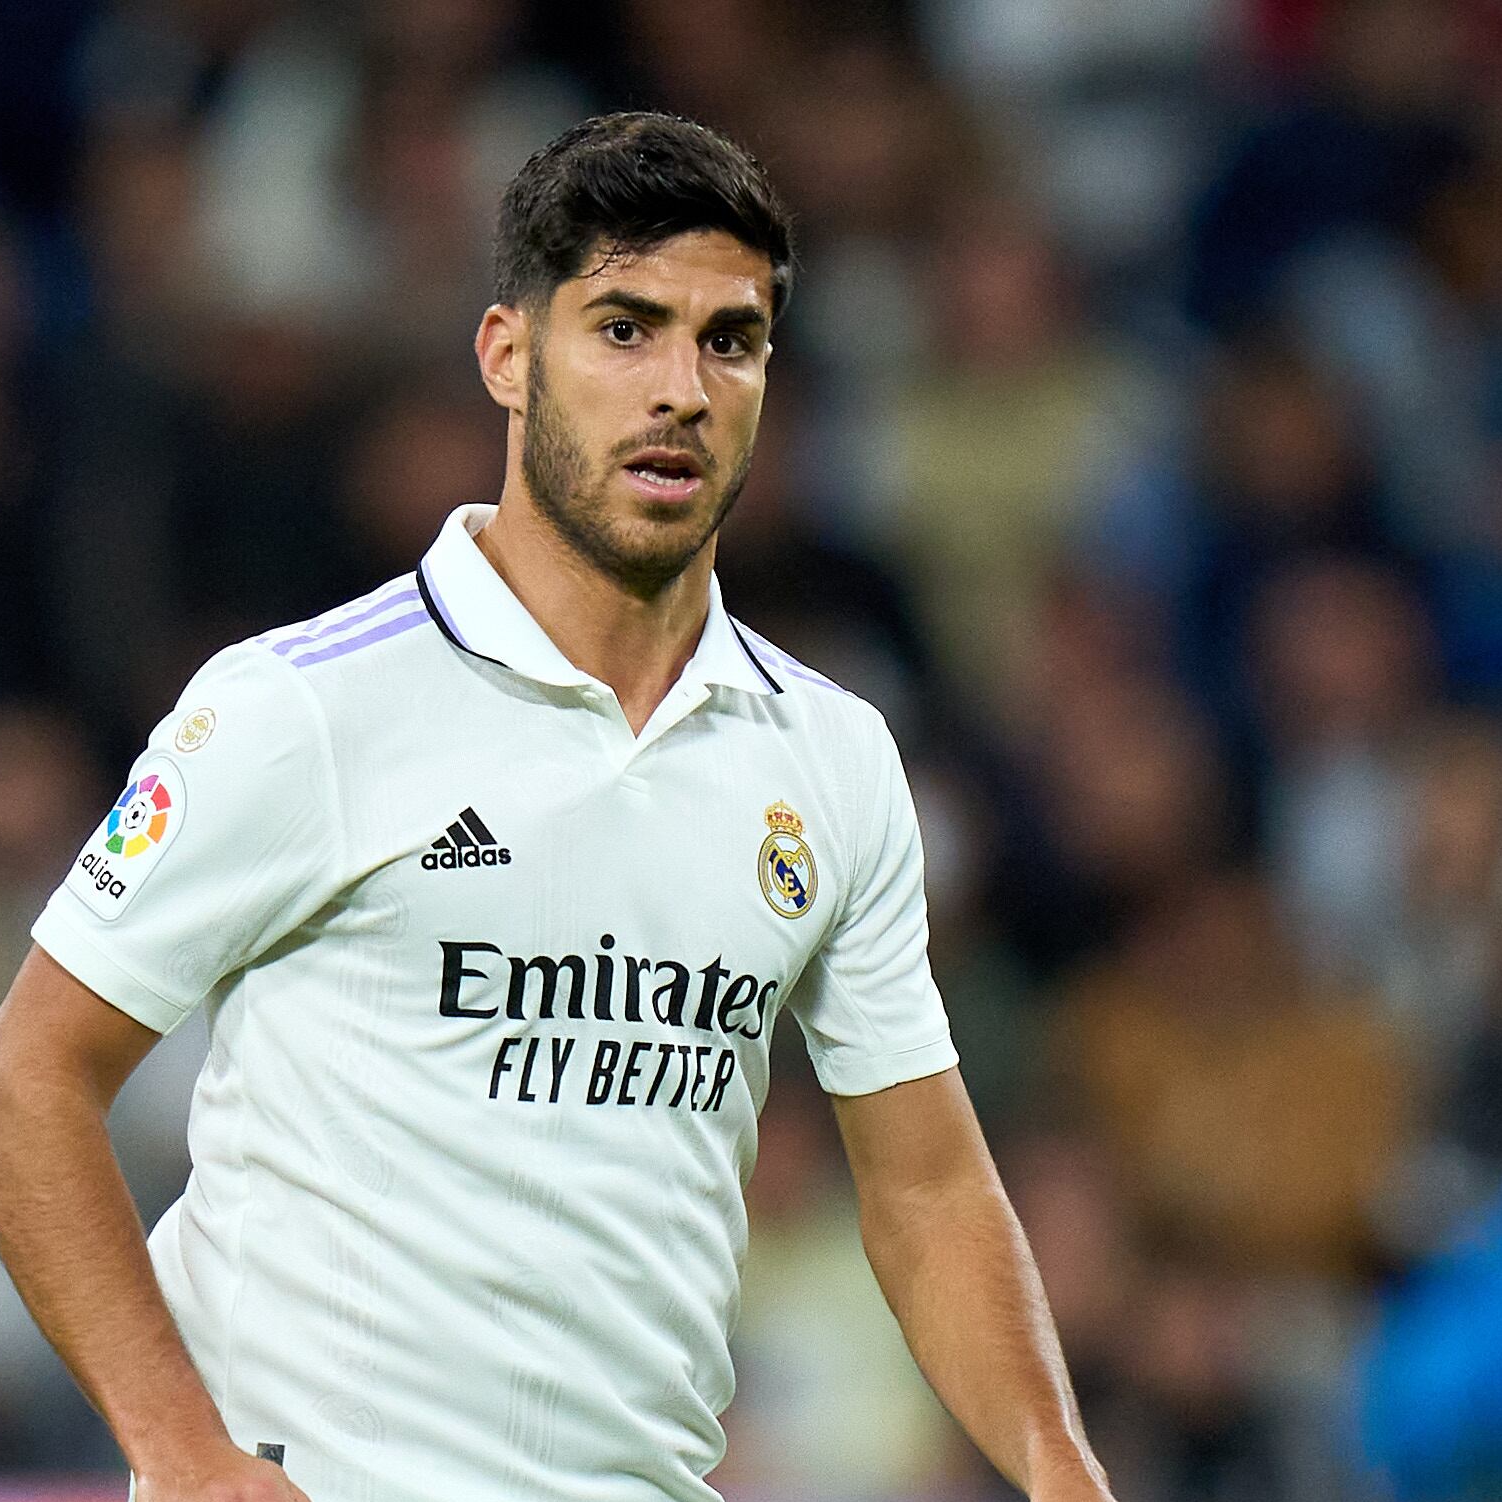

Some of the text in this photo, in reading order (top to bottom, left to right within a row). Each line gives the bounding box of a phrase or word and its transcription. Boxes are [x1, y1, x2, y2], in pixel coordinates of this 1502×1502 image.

[79, 853, 127, 899] aLiga
[421, 846, 512, 870] adidas
[438, 933, 779, 1040] Emirates
[489, 1037, 735, 1112] FLY BETTER
